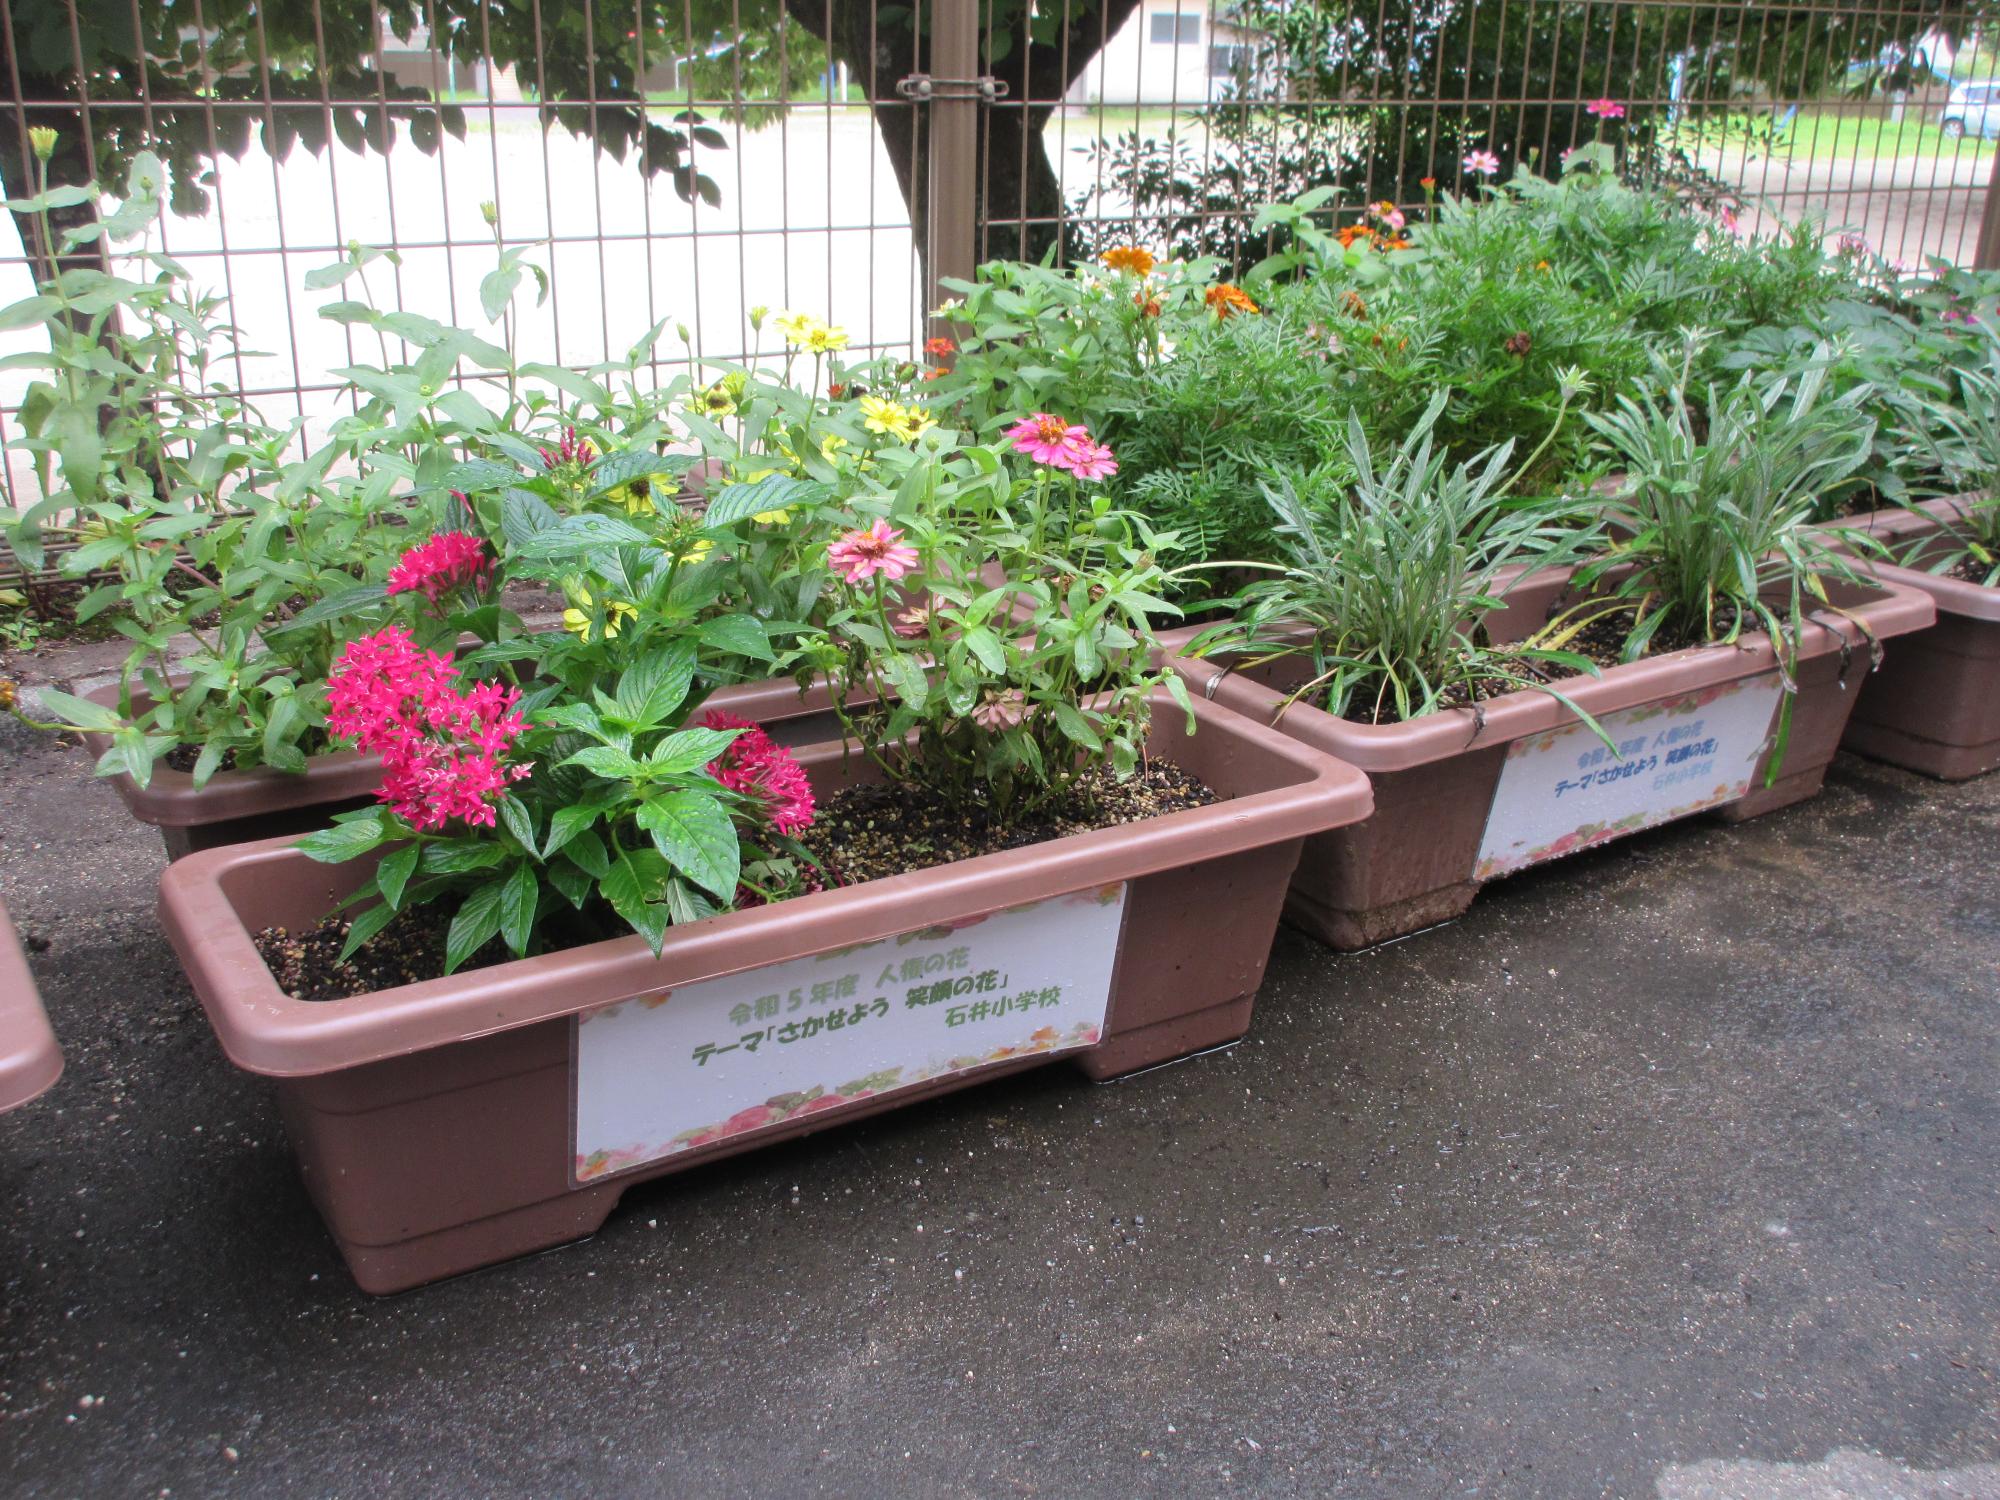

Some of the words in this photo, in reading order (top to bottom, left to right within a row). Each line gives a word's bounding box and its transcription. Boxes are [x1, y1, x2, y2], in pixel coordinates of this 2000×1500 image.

[875, 946, 971, 988] 人権の花
[692, 997, 889, 1066] テーマ「さかせよう
[905, 969, 1009, 1010] 笑顔の花」
[945, 985, 1062, 1028] 石井小学校
